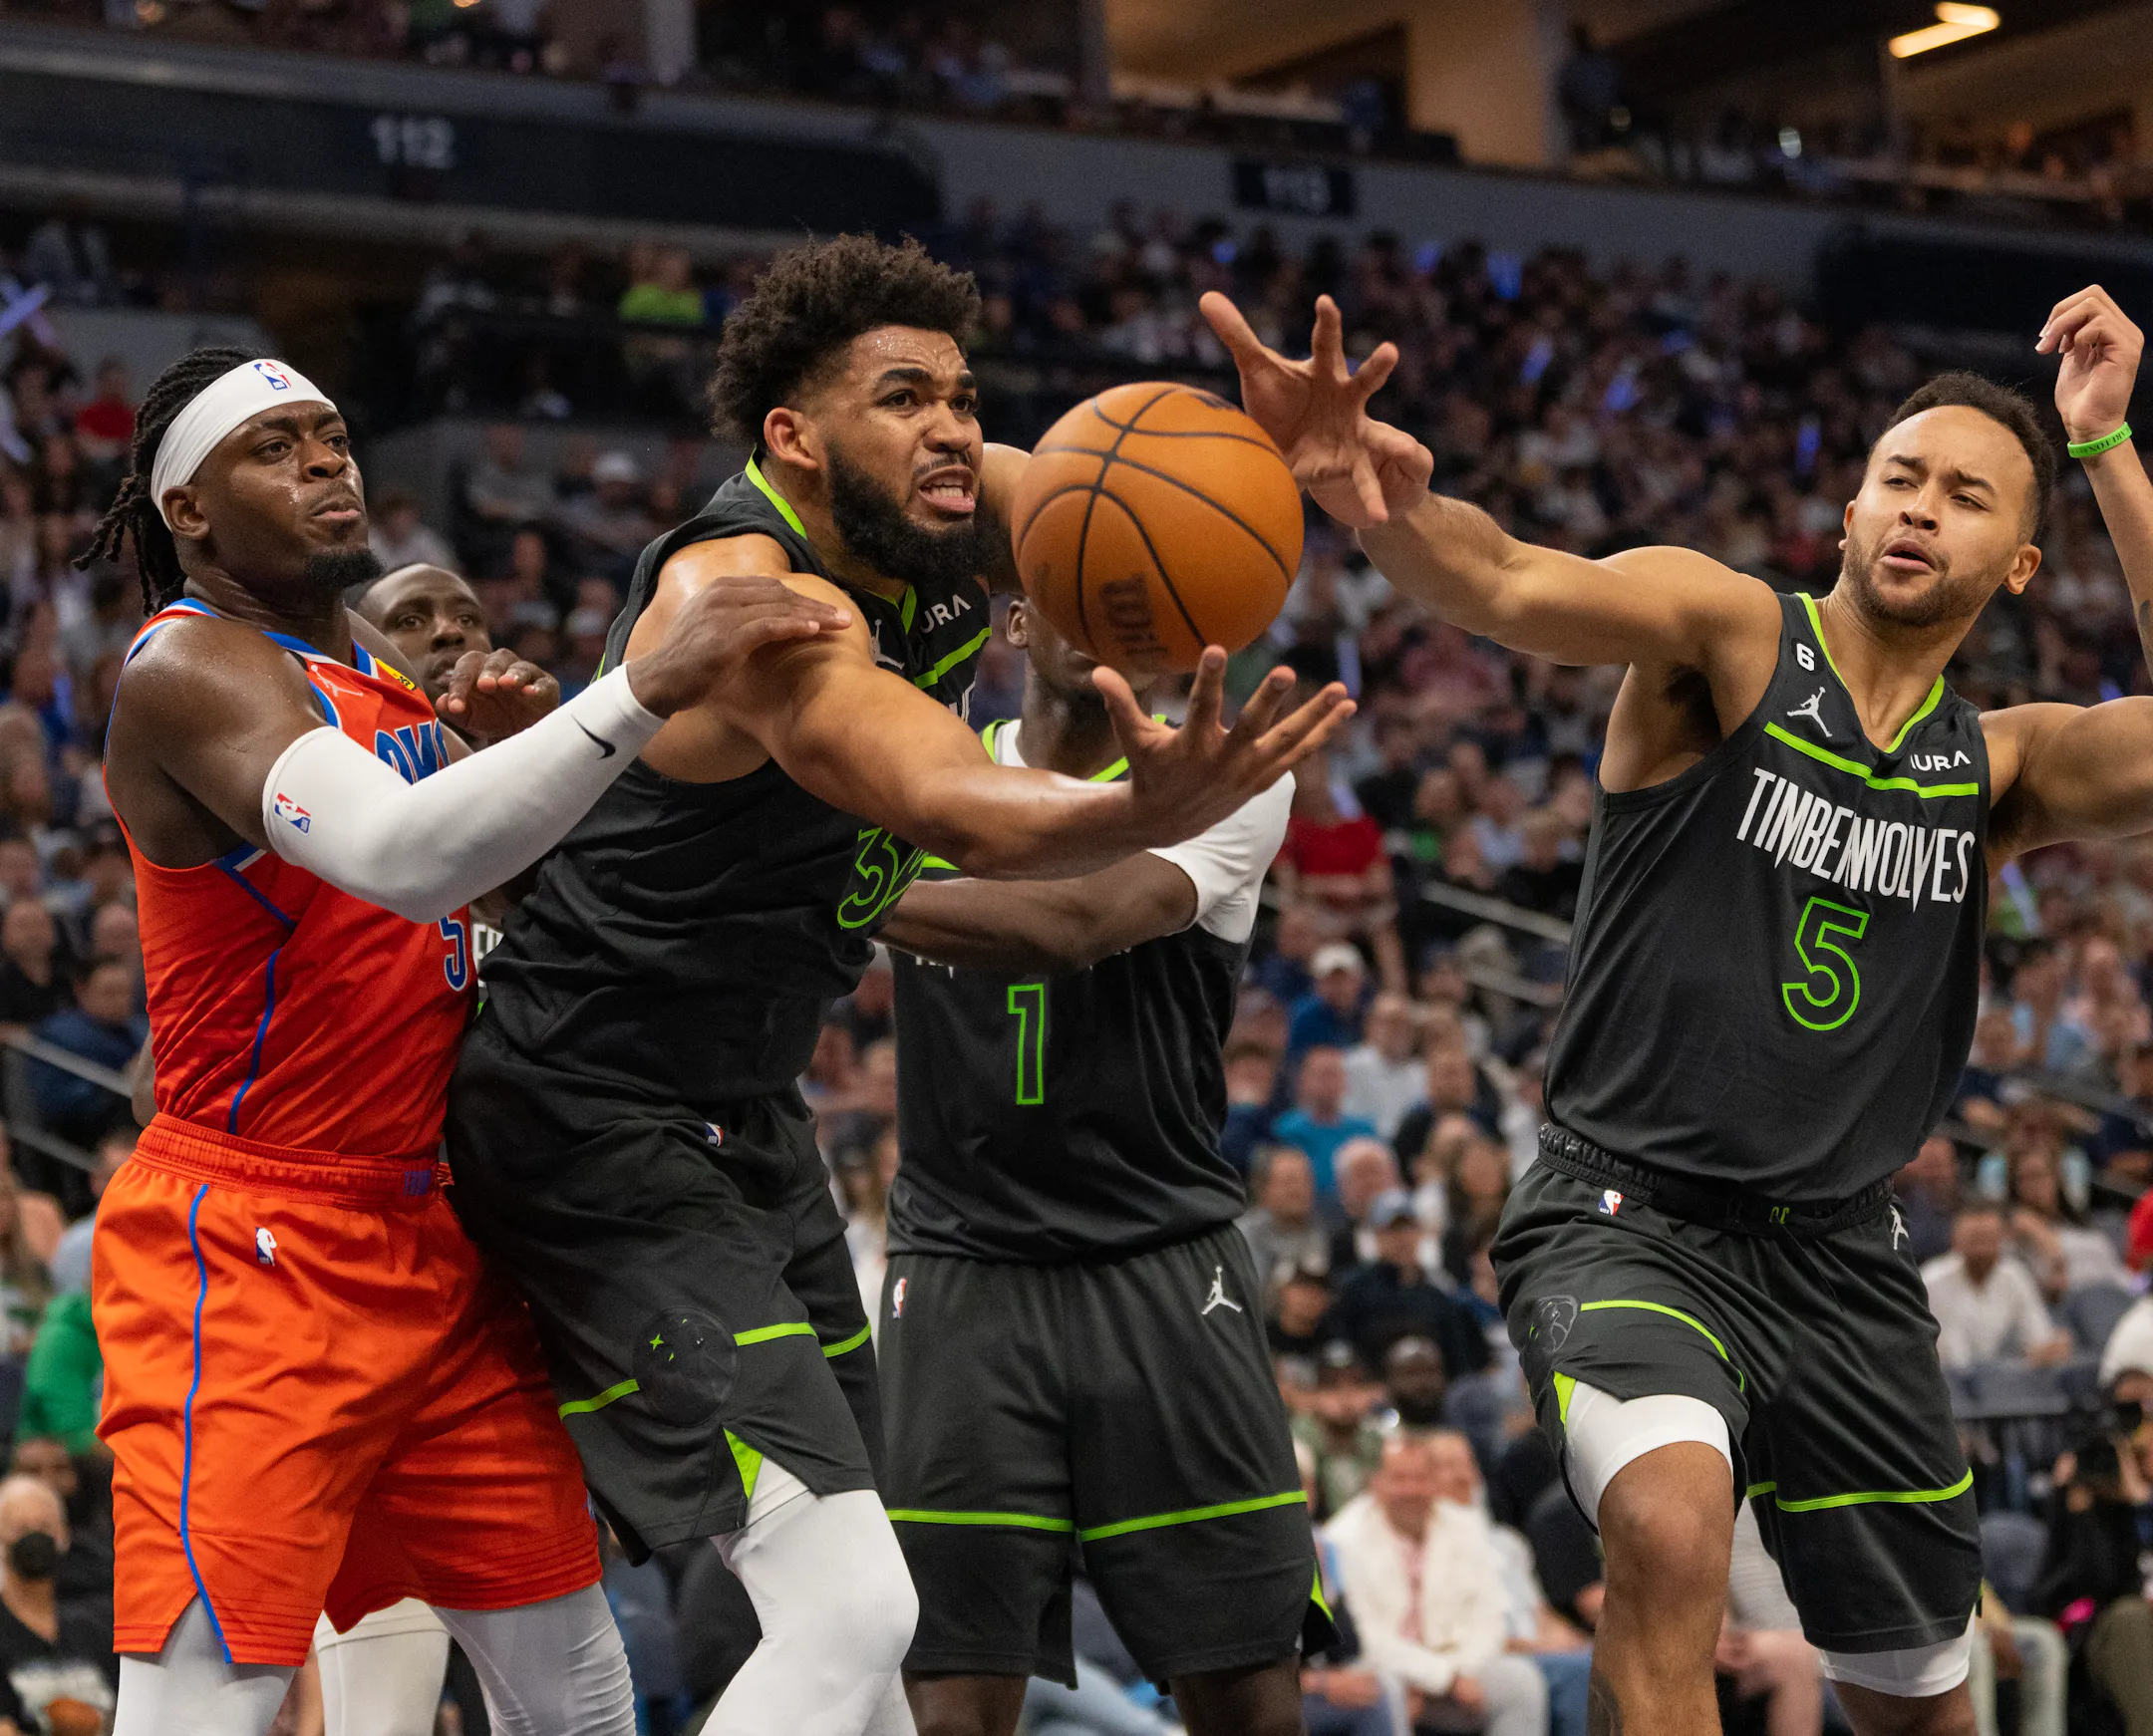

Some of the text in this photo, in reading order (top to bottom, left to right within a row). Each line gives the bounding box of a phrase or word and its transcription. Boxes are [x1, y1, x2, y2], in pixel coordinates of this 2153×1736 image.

[370, 117, 457, 168] 112
[1796, 643, 1815, 672] 6
[439, 916, 468, 992] 5
[1782, 896, 1870, 1030] 5
[1008, 984, 1045, 1105] 1
